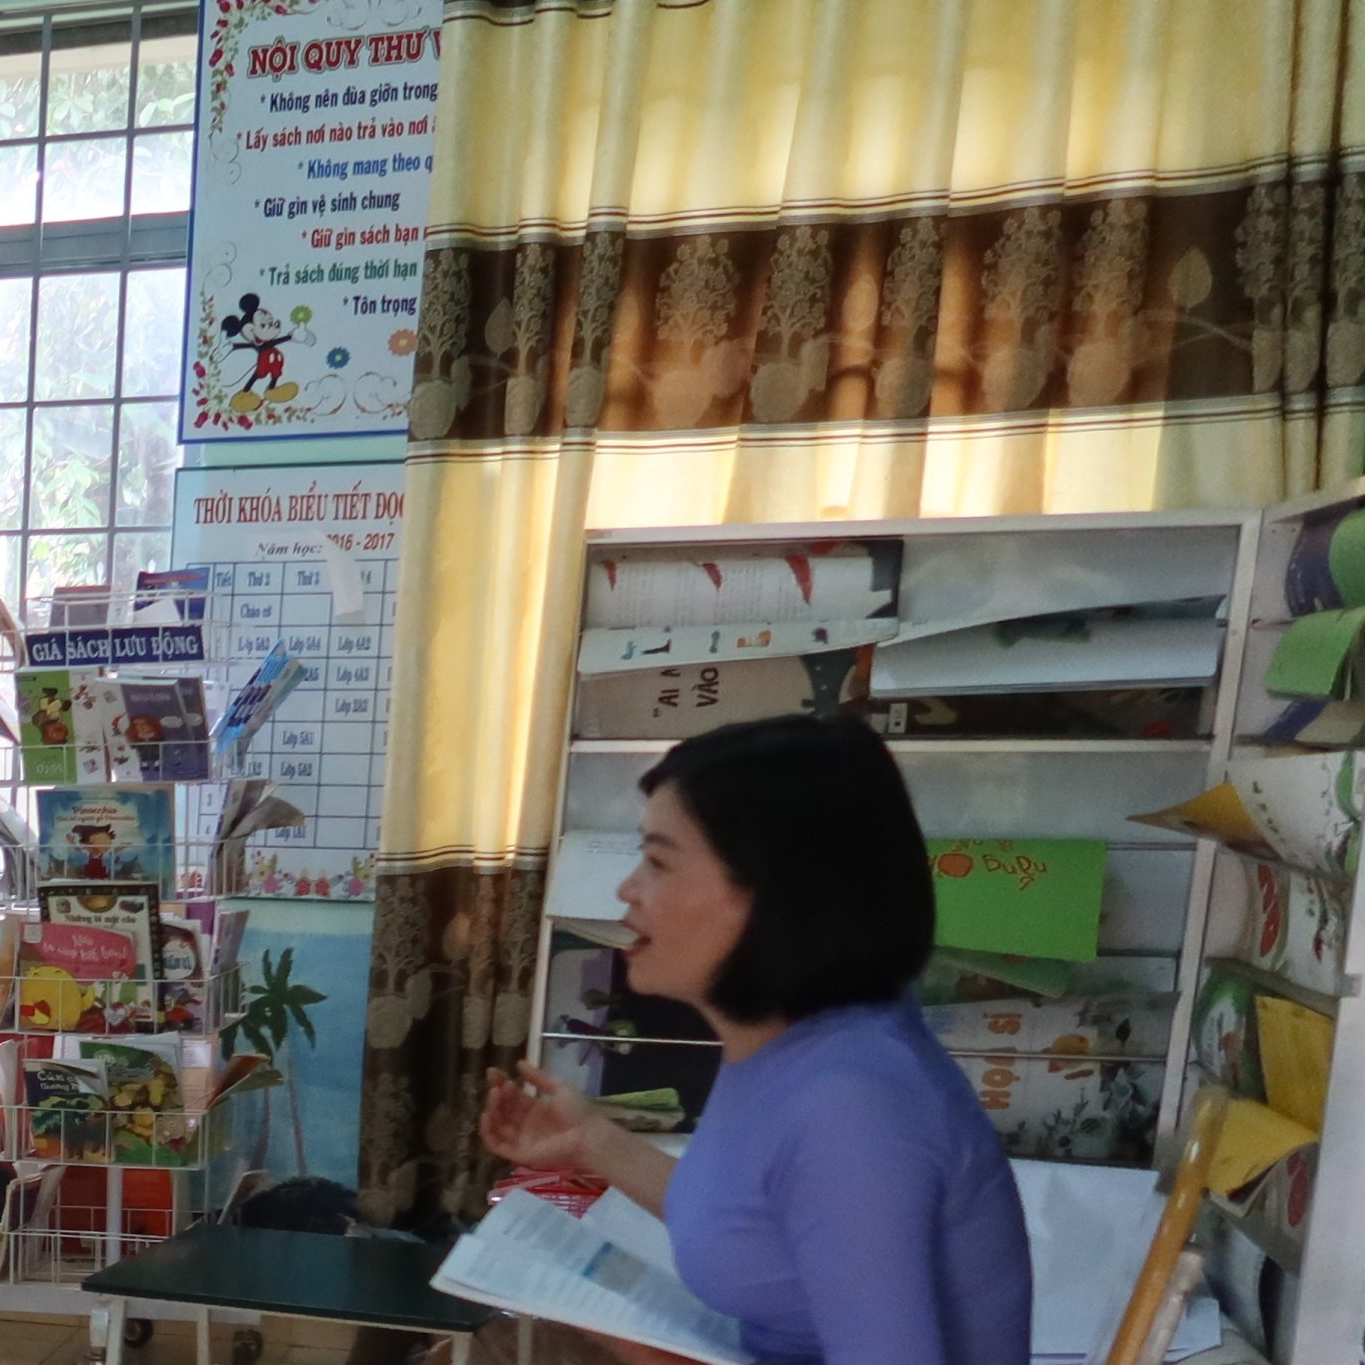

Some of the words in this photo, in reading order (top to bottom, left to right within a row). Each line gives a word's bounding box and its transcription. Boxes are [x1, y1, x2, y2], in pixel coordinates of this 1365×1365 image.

[248, 37, 298, 80] NỘI
[304, 38, 362, 71] QUY
[369, 30, 430, 64] THƯ
[270, 91, 311, 113] Không
[315, 87, 338, 108] nên
[342, 84, 365, 106] đùa
[371, 82, 399, 107] giỡn
[403, 81, 438, 102] trong
[246, 127, 267, 152] Lấy
[272, 124, 301, 148] sách
[329, 121, 352, 141] nào
[357, 116, 376, 140] trả
[381, 117, 403, 138] vào
[307, 158, 349, 181] Không
[352, 155, 387, 178] mang
[392, 152, 421, 173] theo
[263, 197, 286, 218] Giữ
[287, 196, 307, 219] gìn
[312, 195, 326, 218] vệ
[330, 192, 357, 212] sinh
[361, 190, 401, 212] chung
[311, 229, 333, 249] Giữ
[335, 227, 355, 250] gìn
[360, 225, 390, 245] sách
[395, 223, 419, 247] bạn
[269, 263, 290, 286] Trả
[294, 264, 324, 284] sách
[328, 262, 360, 284] đúng
[364, 259, 389, 280] thời
[393, 259, 417, 283] hạn
[353, 295, 377, 316] Tôn
[380, 294, 417, 317] trọng
[194, 489, 233, 525] THỜI
[236, 488, 283, 524] KHÓA
[287, 480, 329, 522] BIỂU
[333, 480, 371, 521] TIẾT
[363, 532, 395, 551] 2017
[32, 638, 63, 662] GIÁ
[66, 635, 110, 660] SÁCH
[113, 634, 147, 657] LƯU
[152, 631, 199, 659] ĐỘNG
[288, 636, 304, 655] Lớp
[337, 636, 354, 654] Lớp
[336, 666, 352, 685] Lớp
[691, 667, 720, 708] VÀO
[334, 697, 352, 717] Lớp
[282, 730, 298, 749] Lớp
[280, 761, 296, 780] Lớp
